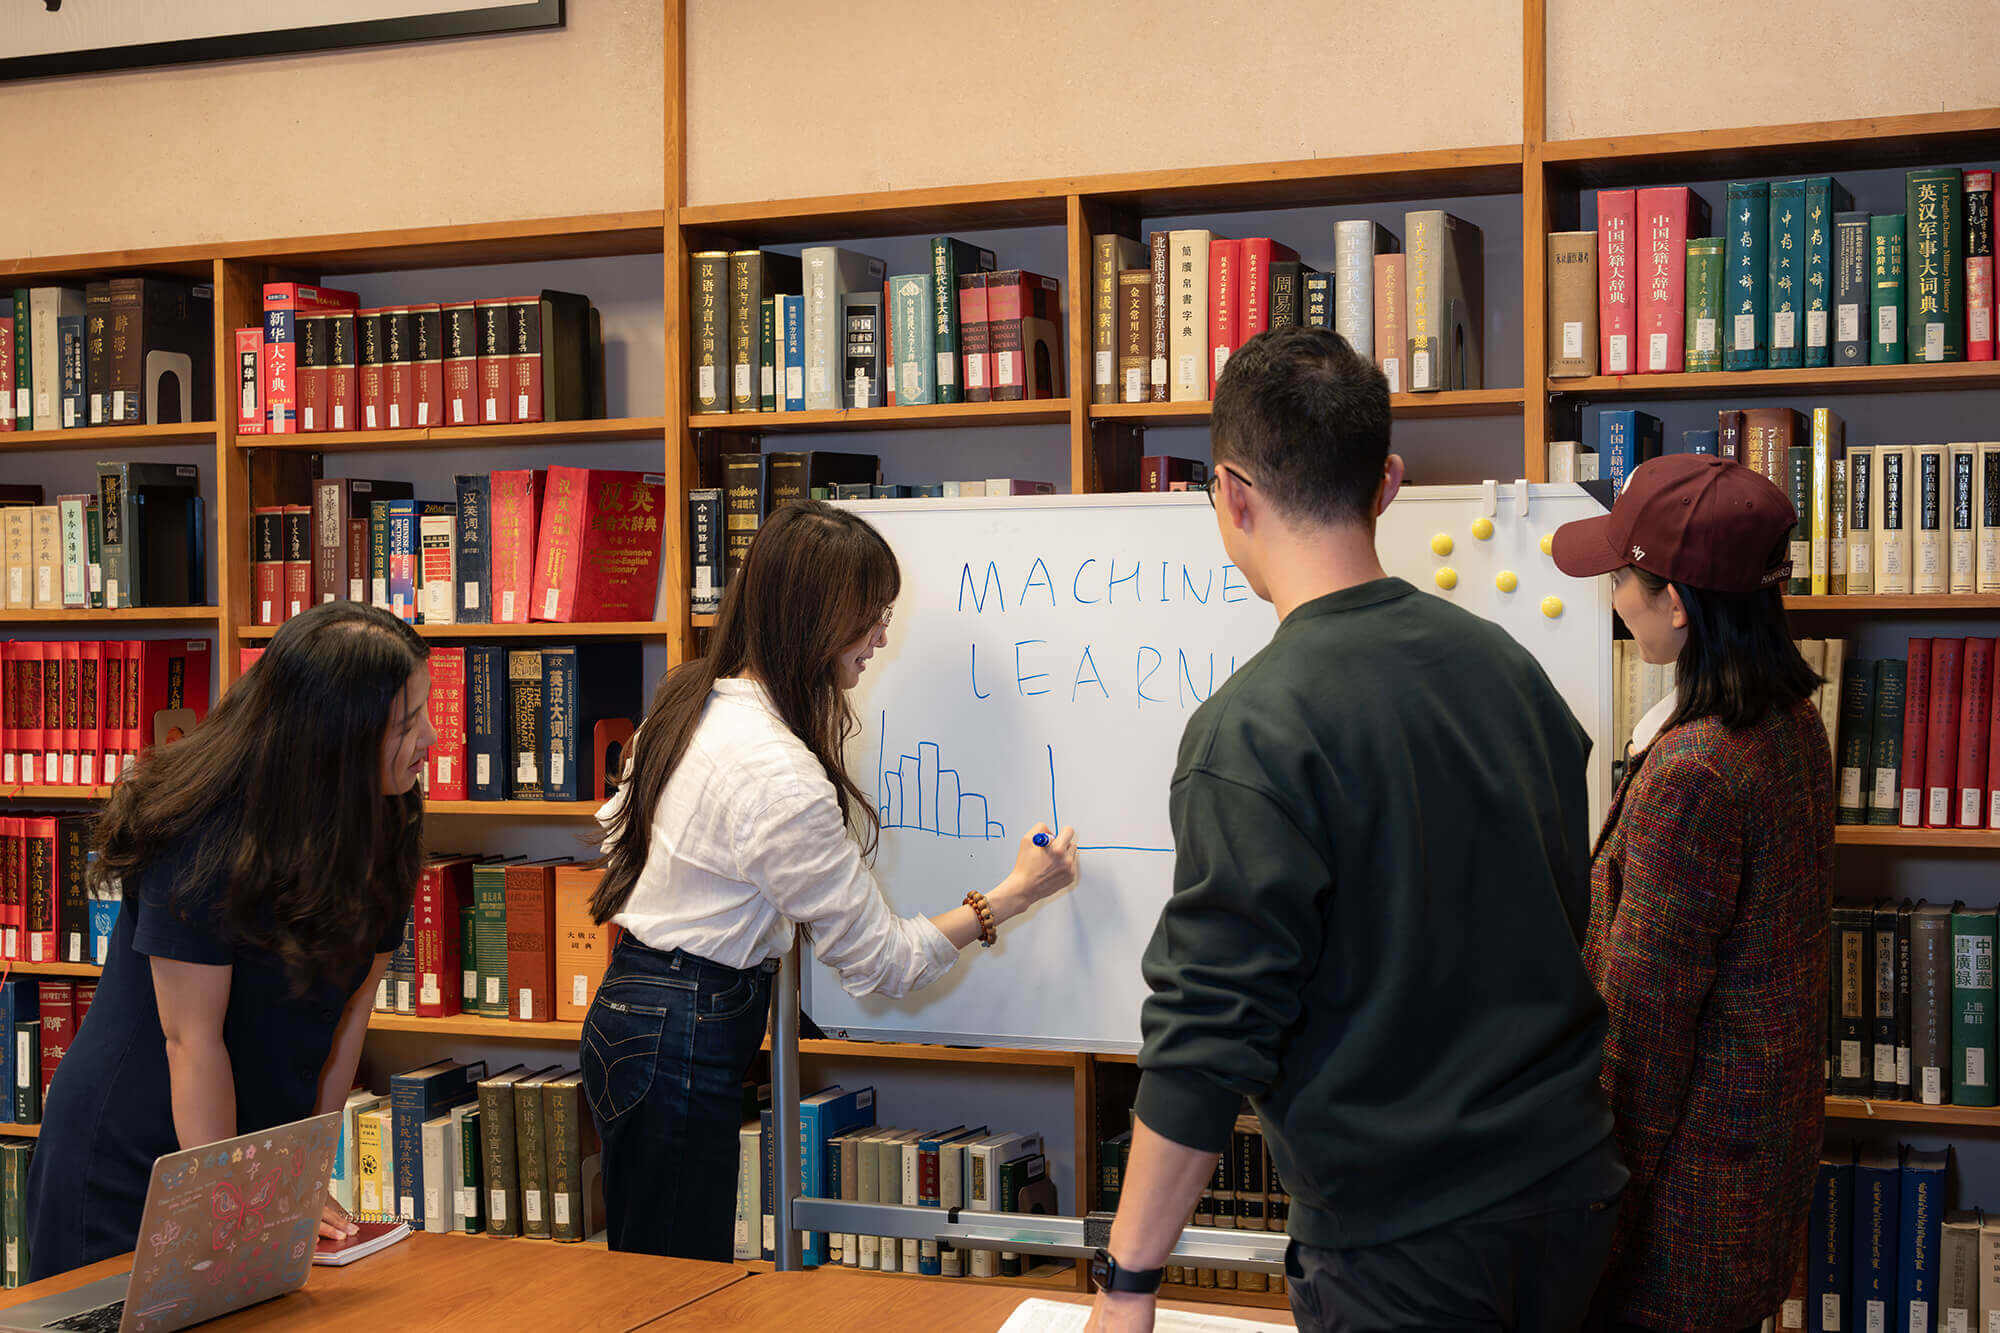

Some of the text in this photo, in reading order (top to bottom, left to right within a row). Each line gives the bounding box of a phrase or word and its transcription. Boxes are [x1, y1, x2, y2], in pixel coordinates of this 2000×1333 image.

[1181, 246, 1193, 337] 簡牘帛書字典
[1607, 216, 1625, 305] 中国医籍大辞典
[1652, 214, 1670, 302] 中国医籍大辞典
[1918, 183, 1937, 315] 英汉军事大词典
[270, 311, 287, 393] 新华大字典
[702, 264, 715, 367] 汉语方言大词典
[737, 262, 749, 365] 汉语方言大词典
[1129, 286, 1140, 355] 金文常用字典
[1723, 428, 1736, 457] 中国
[463, 491, 479, 542] 汉英词典
[958, 557, 1249, 614] MACHINE
[519, 687, 528, 748] DICTIONARY
[1849, 1026, 1855, 1035] 2
[1880, 1026, 1888, 1035] 3
[486, 1094, 502, 1191] 汉语方言大词典
[522, 1095, 539, 1191] 汉语方言大词典
[551, 1095, 568, 1194] 汉语方言大词典
